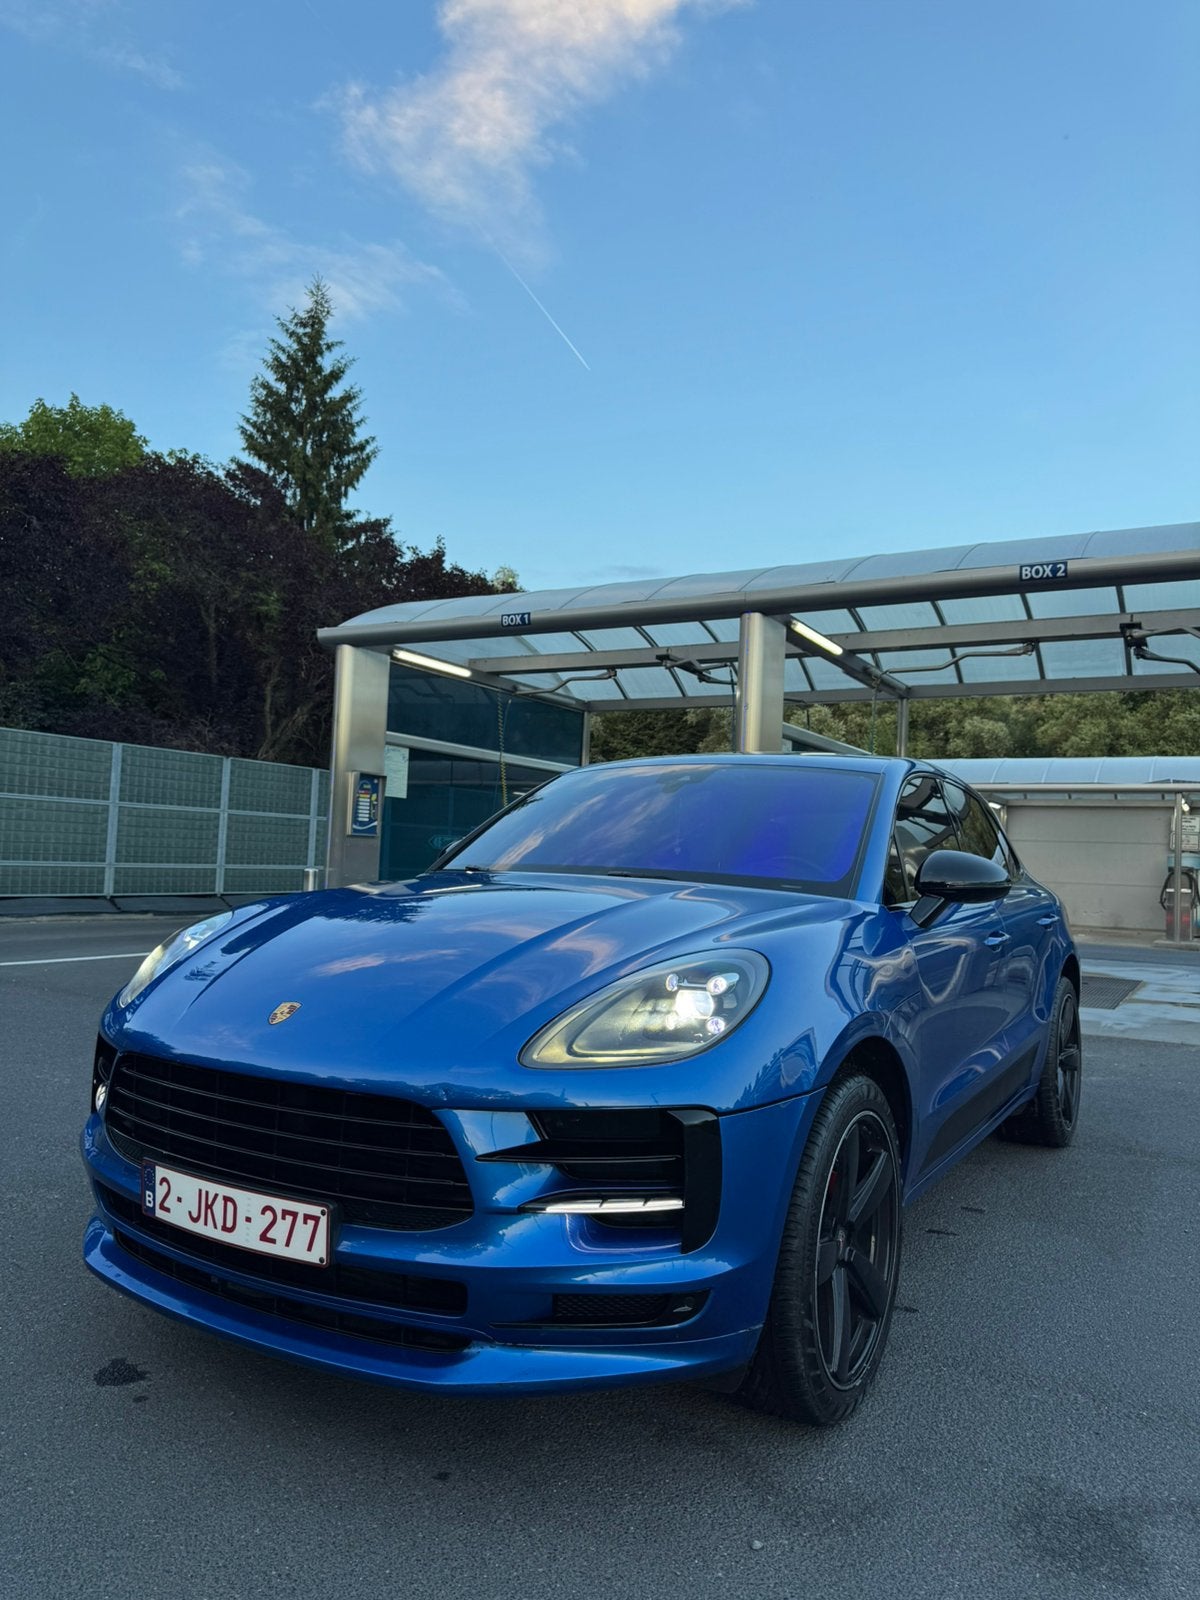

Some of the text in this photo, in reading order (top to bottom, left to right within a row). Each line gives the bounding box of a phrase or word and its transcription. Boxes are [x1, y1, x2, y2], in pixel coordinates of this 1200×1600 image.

[1021, 563, 1066, 580] BOX 2
[502, 613, 529, 626] BOX 1
[145, 1176, 321, 1253] B 2-JKD-277
